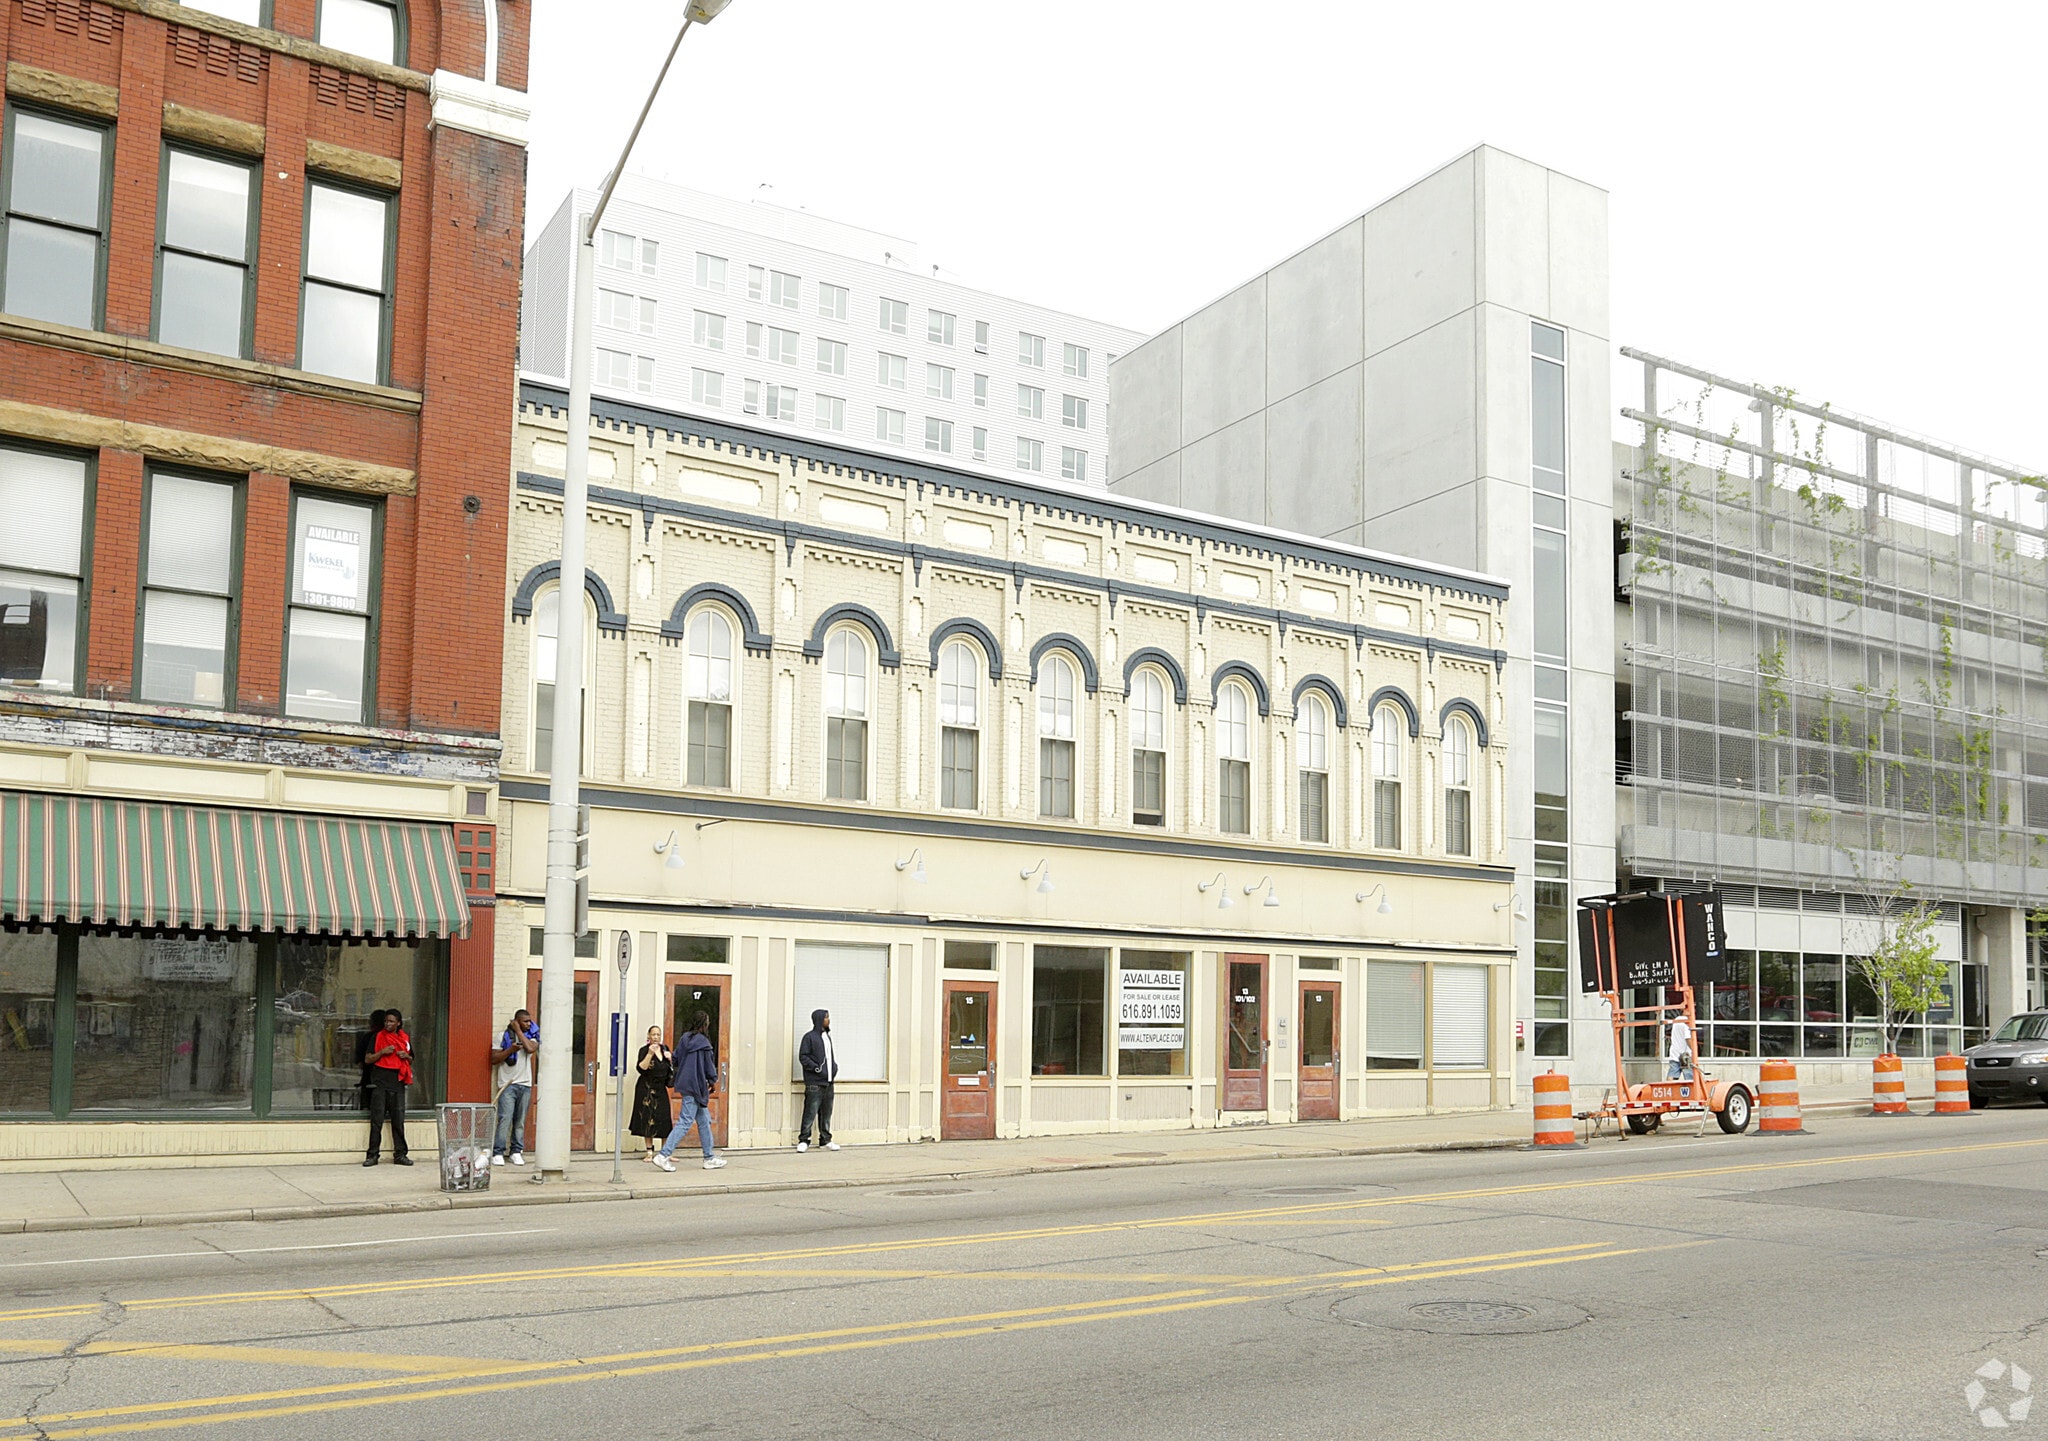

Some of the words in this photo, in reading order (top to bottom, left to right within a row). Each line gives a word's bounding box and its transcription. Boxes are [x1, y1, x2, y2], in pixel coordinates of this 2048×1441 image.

[308, 526, 359, 545] AVAILABLE
[309, 593, 356, 610] 301-9800
[1704, 903, 1716, 951] WANCO
[1123, 973, 1181, 985] AVAILABLE
[694, 992, 702, 1000] 17
[1122, 1004, 1181, 1019] 616.891.1059
[1120, 1034, 1183, 1043] WWW.ALTENPLACE.COM
[1653, 1087, 1672, 1098] G514
[1680, 1087, 1690, 1096] W
